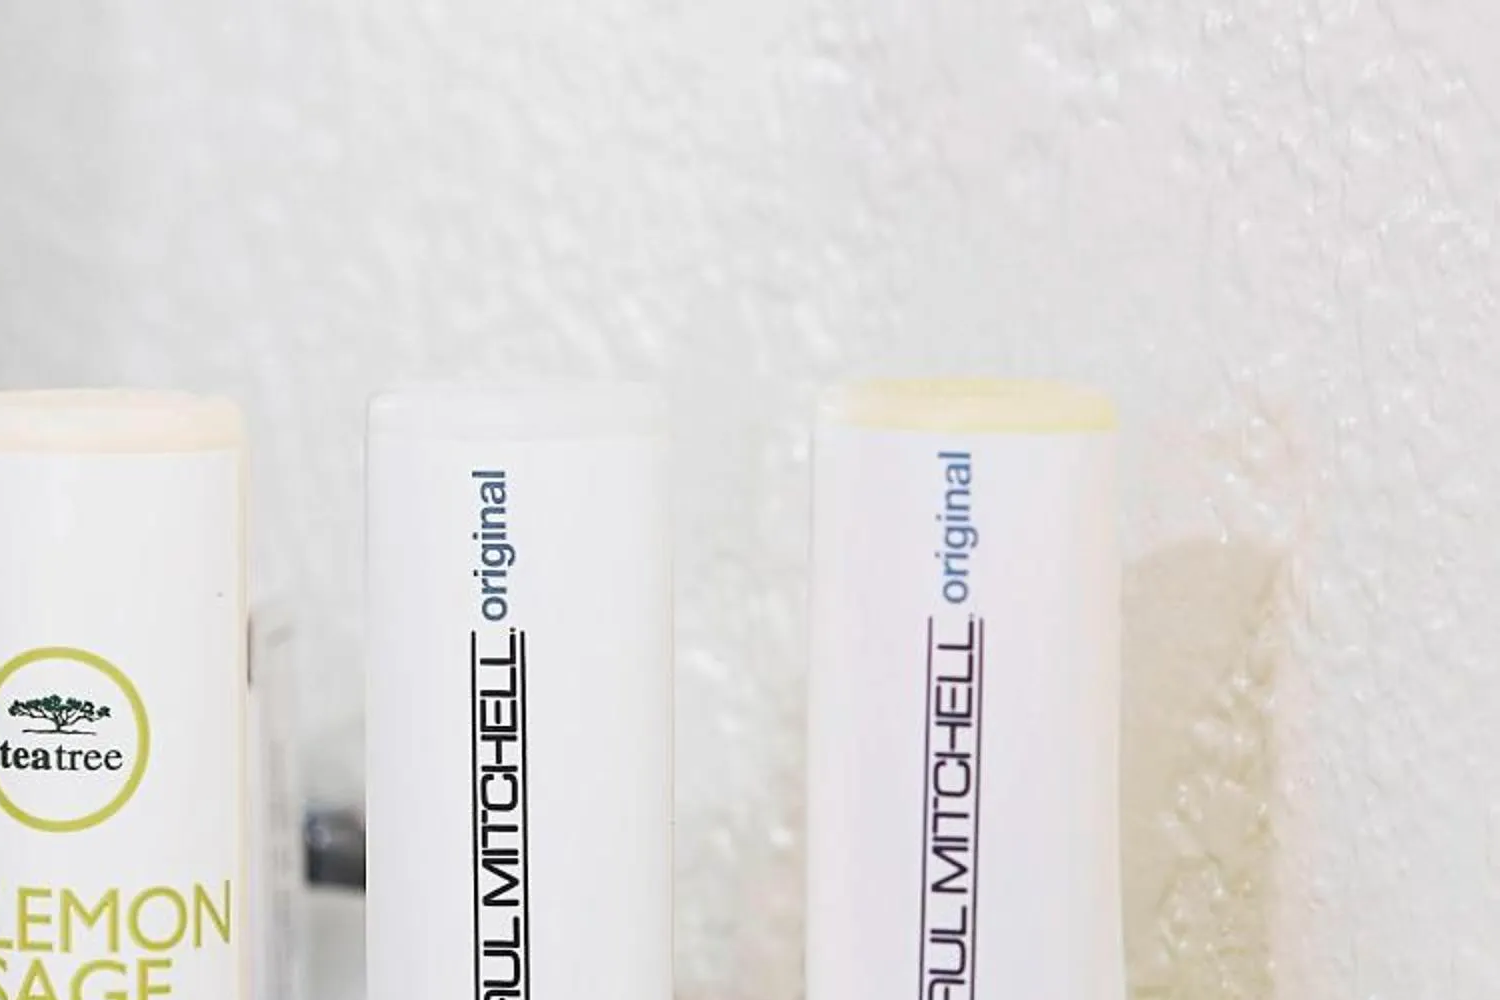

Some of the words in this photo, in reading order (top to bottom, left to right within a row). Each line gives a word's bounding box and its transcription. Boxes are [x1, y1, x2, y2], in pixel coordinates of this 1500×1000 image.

[472, 470, 516, 621] original
[935, 451, 979, 605] original
[479, 631, 520, 907] MITCHELL
[931, 619, 976, 893] MITCHELL
